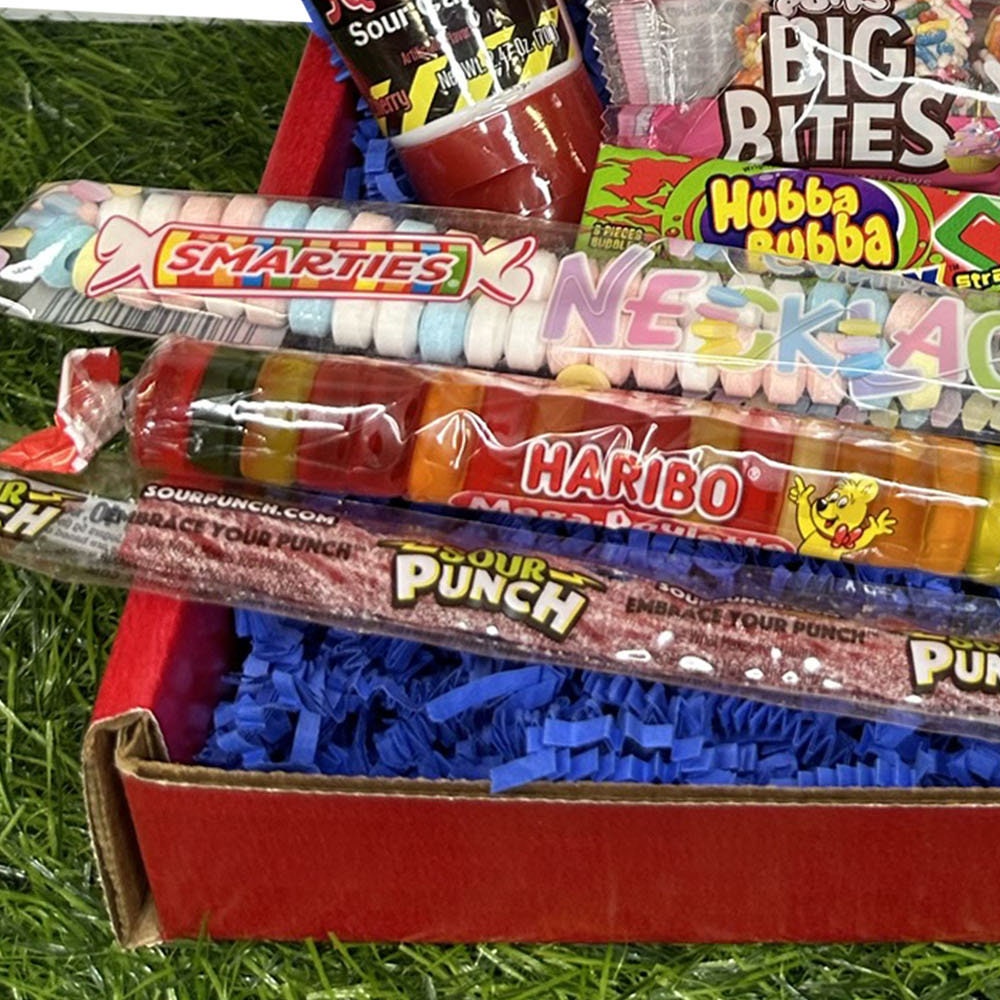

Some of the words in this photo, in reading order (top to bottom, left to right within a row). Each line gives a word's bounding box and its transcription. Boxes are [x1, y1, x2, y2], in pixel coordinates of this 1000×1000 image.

[350, 4, 412, 47] Sour
[768, 14, 909, 98] BIG
[722, 82, 955, 168] BITES
[710, 176, 859, 234] Hubba
[166, 241, 460, 283] SMARTIES
[747, 210, 894, 268] Bubba
[144, 485, 339, 526] SOURPUNCH.COM
[521, 440, 743, 523] HARIBO
[212, 520, 271, 546] YOUR
[276, 535, 352, 561] PUNCH
[440, 547, 547, 583] SOUR
[395, 553, 588, 636] PUNCH
[626, 597, 721, 625] EMBRACE
[729, 607, 788, 633] YOUR
[792, 622, 866, 645] PUNCH
